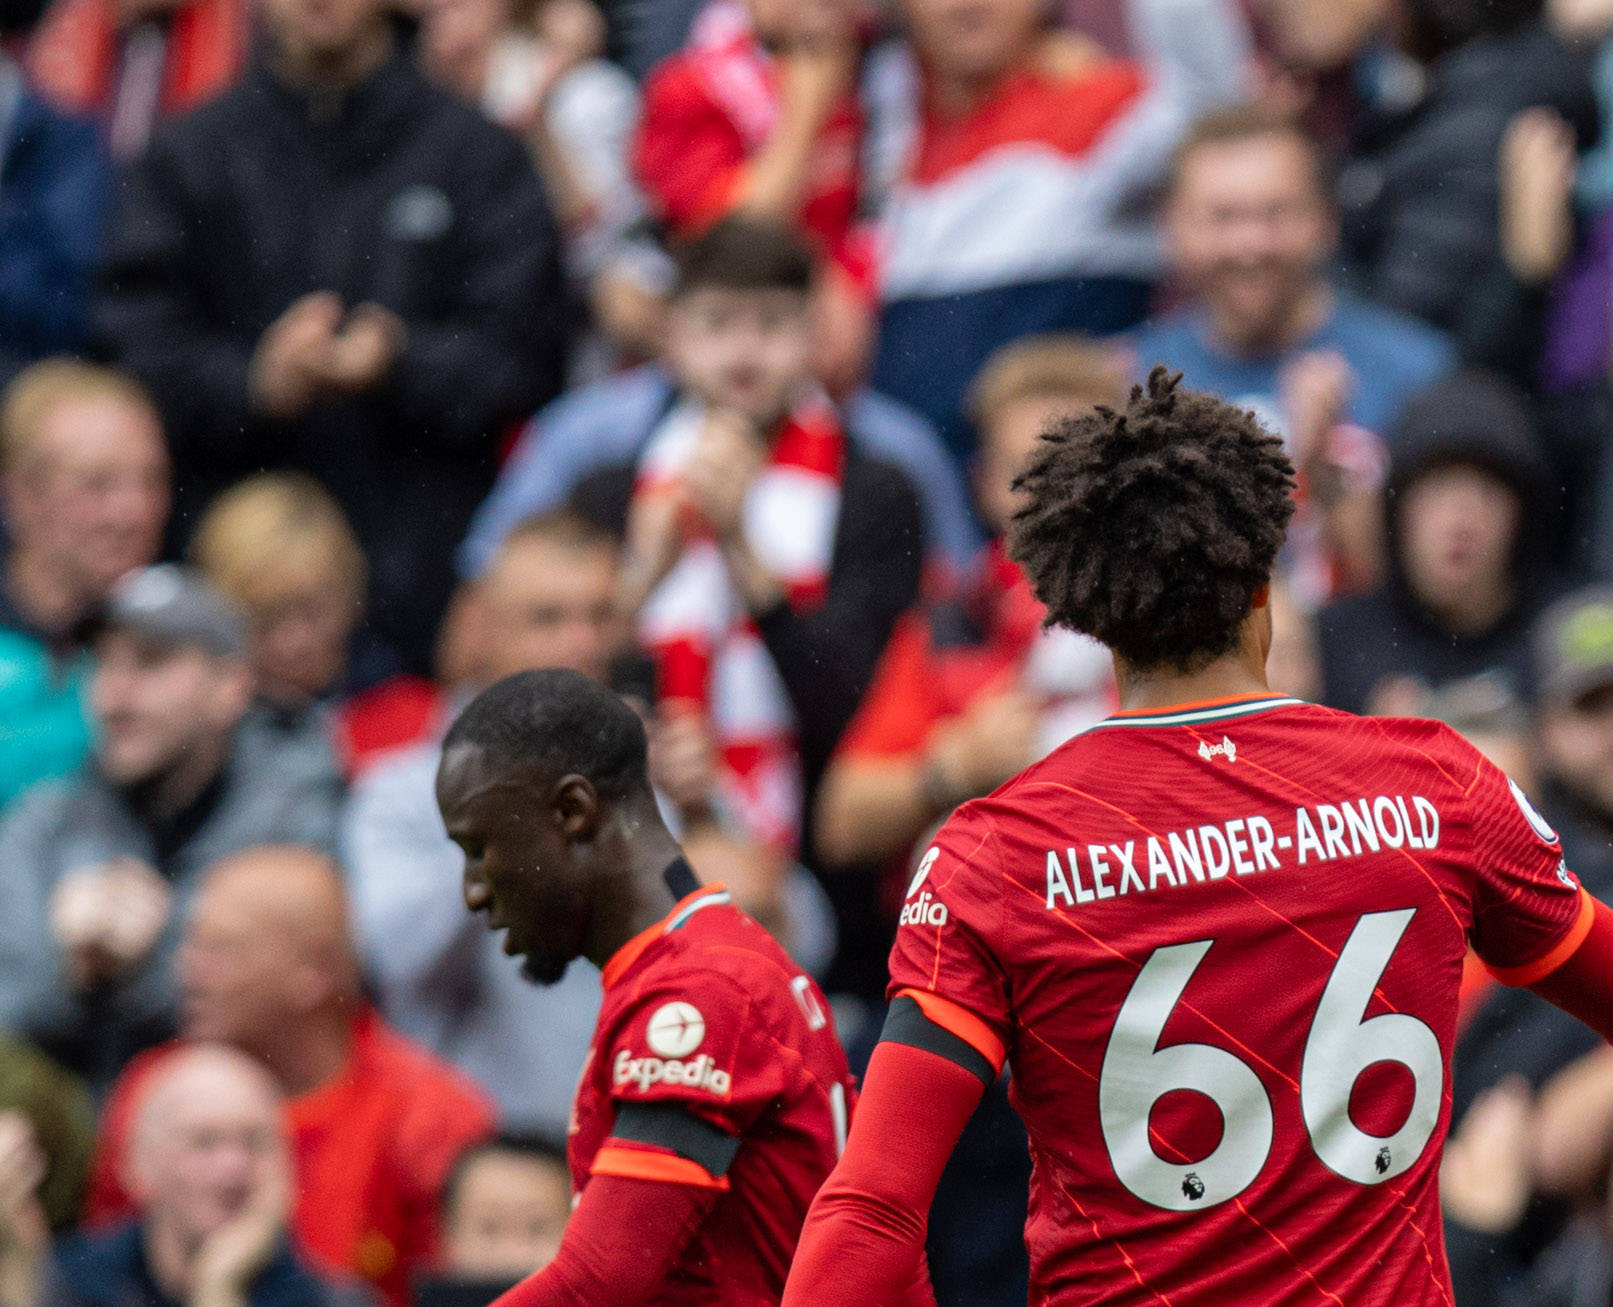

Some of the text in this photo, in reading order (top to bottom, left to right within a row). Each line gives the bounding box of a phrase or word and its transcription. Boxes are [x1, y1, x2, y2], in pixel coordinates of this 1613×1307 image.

[1045, 795, 1441, 910] ALEXANDER-ARNOLD
[899, 891, 948, 926] edia
[613, 1050, 731, 1094] Expedia
[1098, 906, 1444, 1212] 66
